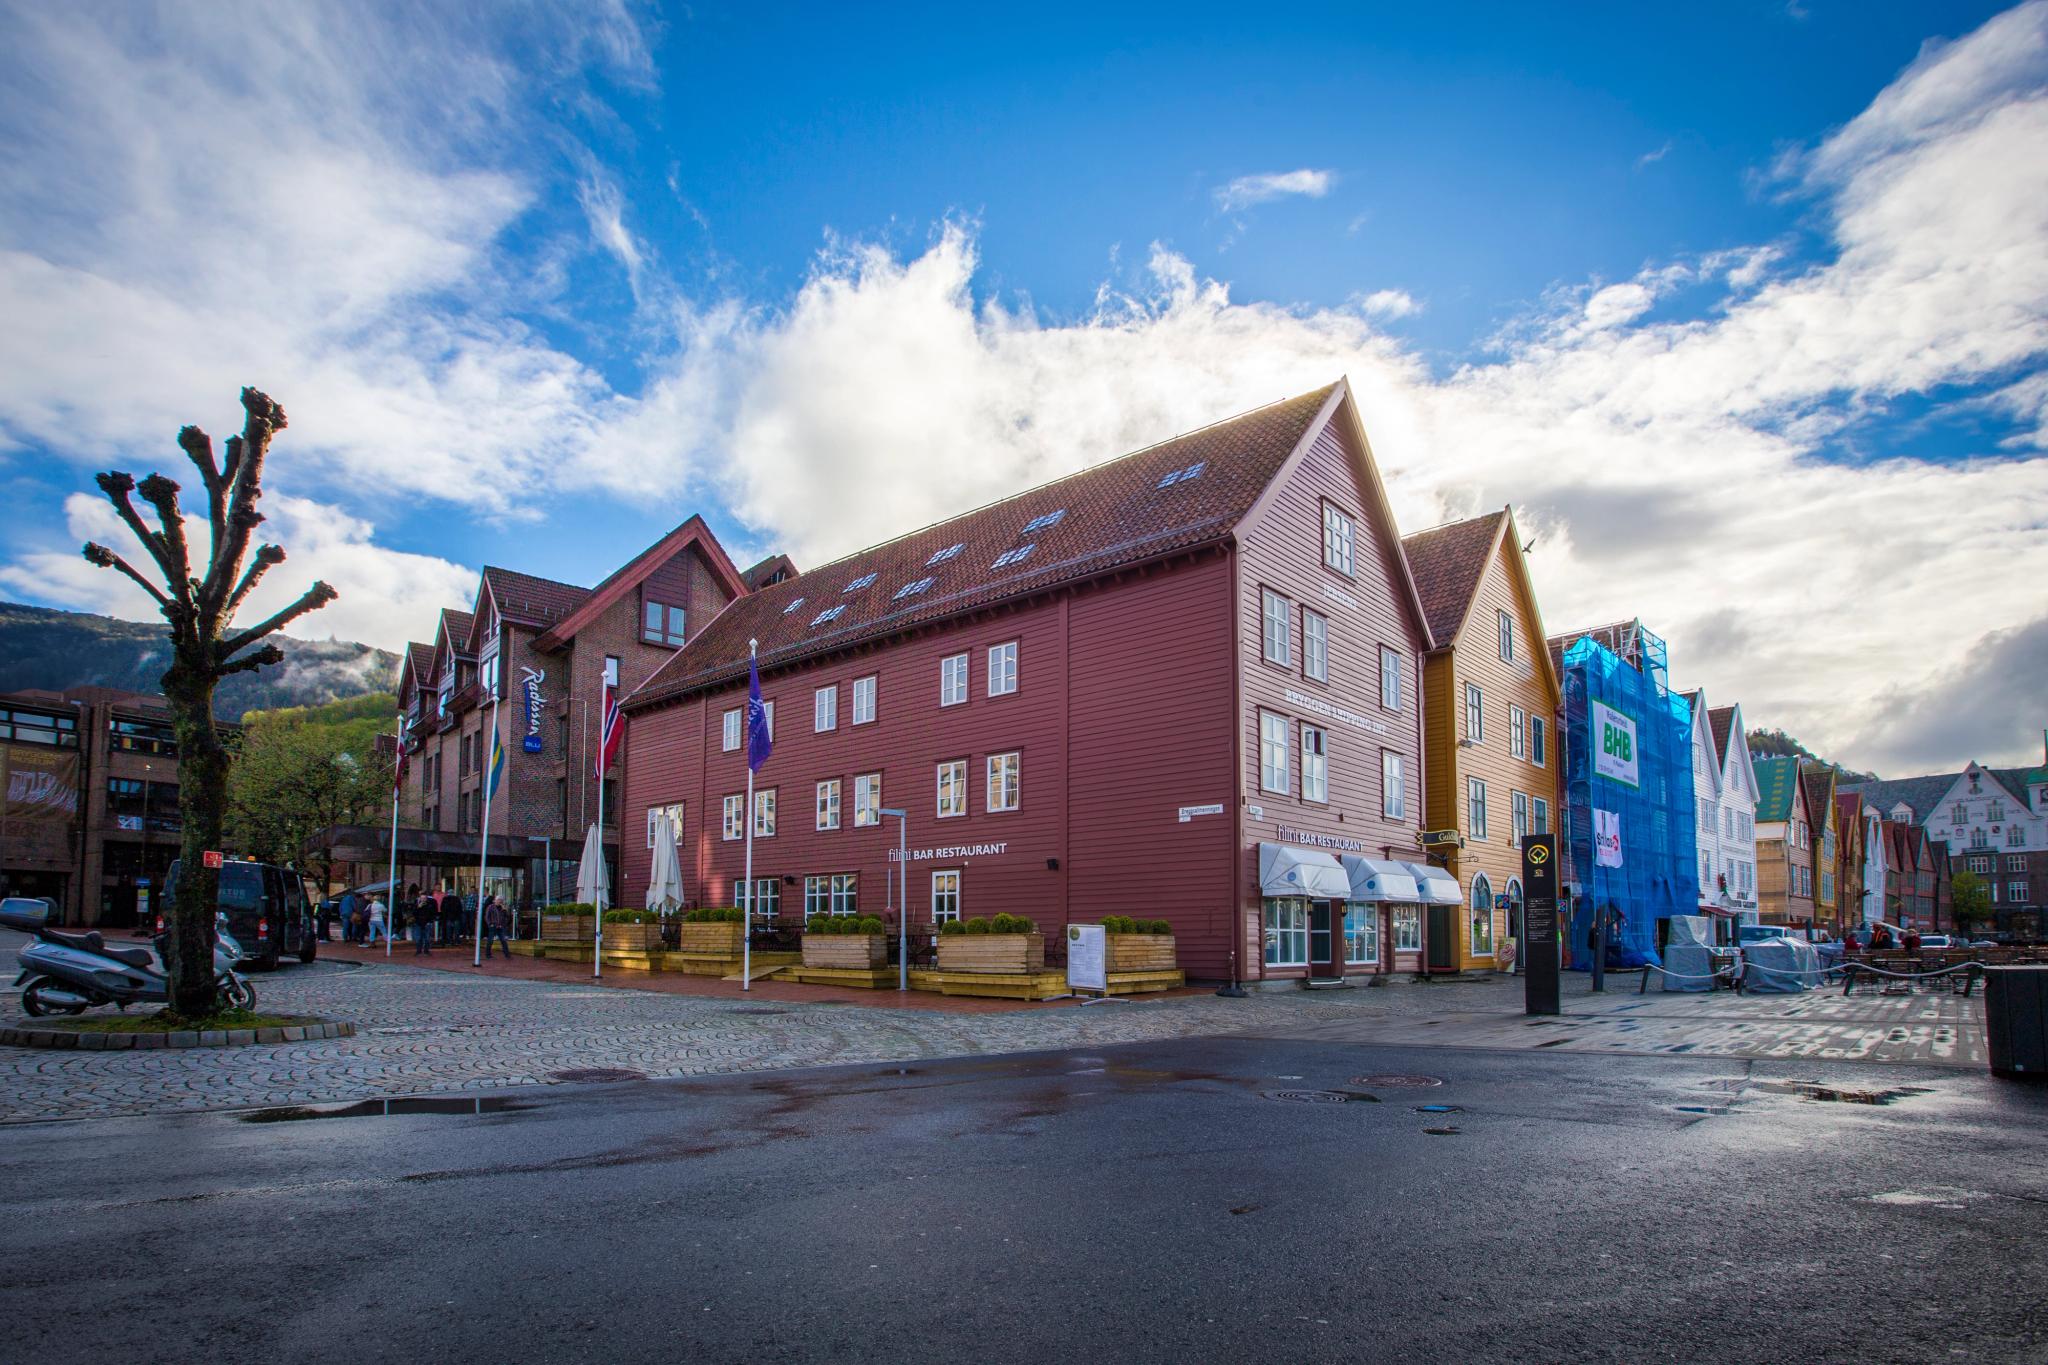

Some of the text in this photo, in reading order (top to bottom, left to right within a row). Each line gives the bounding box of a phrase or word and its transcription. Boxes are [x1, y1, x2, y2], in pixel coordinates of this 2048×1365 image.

[520, 666, 548, 736] Radisson
[1604, 721, 1632, 762] BHB
[913, 849, 934, 860] BAR
[936, 843, 1007, 859] RESTAURANT
[1300, 832, 1317, 845] BAR
[1317, 835, 1364, 852] RESTAURANT
